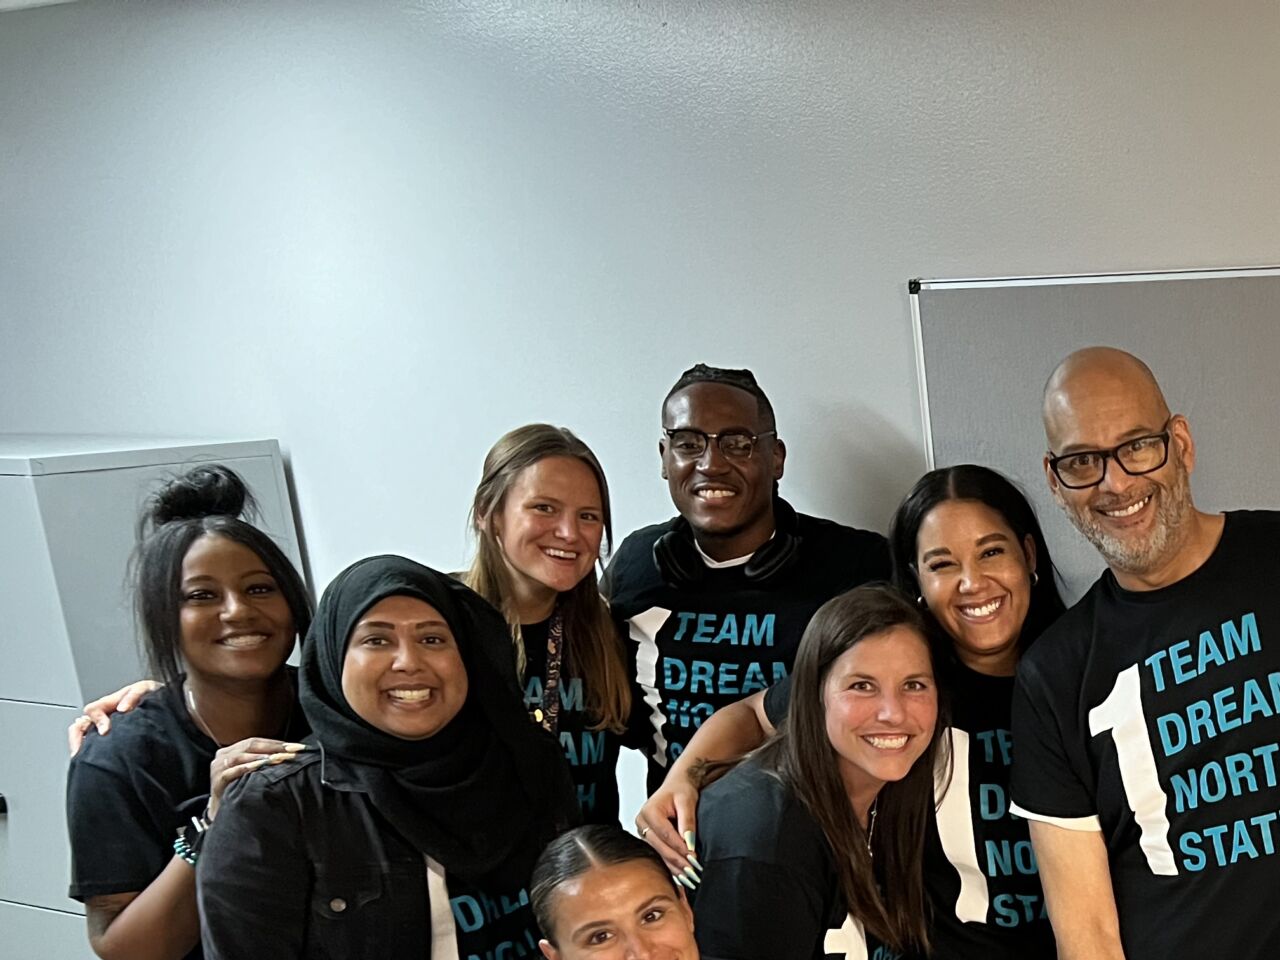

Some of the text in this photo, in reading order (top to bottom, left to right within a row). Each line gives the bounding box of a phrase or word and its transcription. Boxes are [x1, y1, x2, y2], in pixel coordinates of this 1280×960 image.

[674, 612, 776, 646] TEAM
[1145, 613, 1262, 692] TEAM
[1089, 663, 1179, 875] 1
